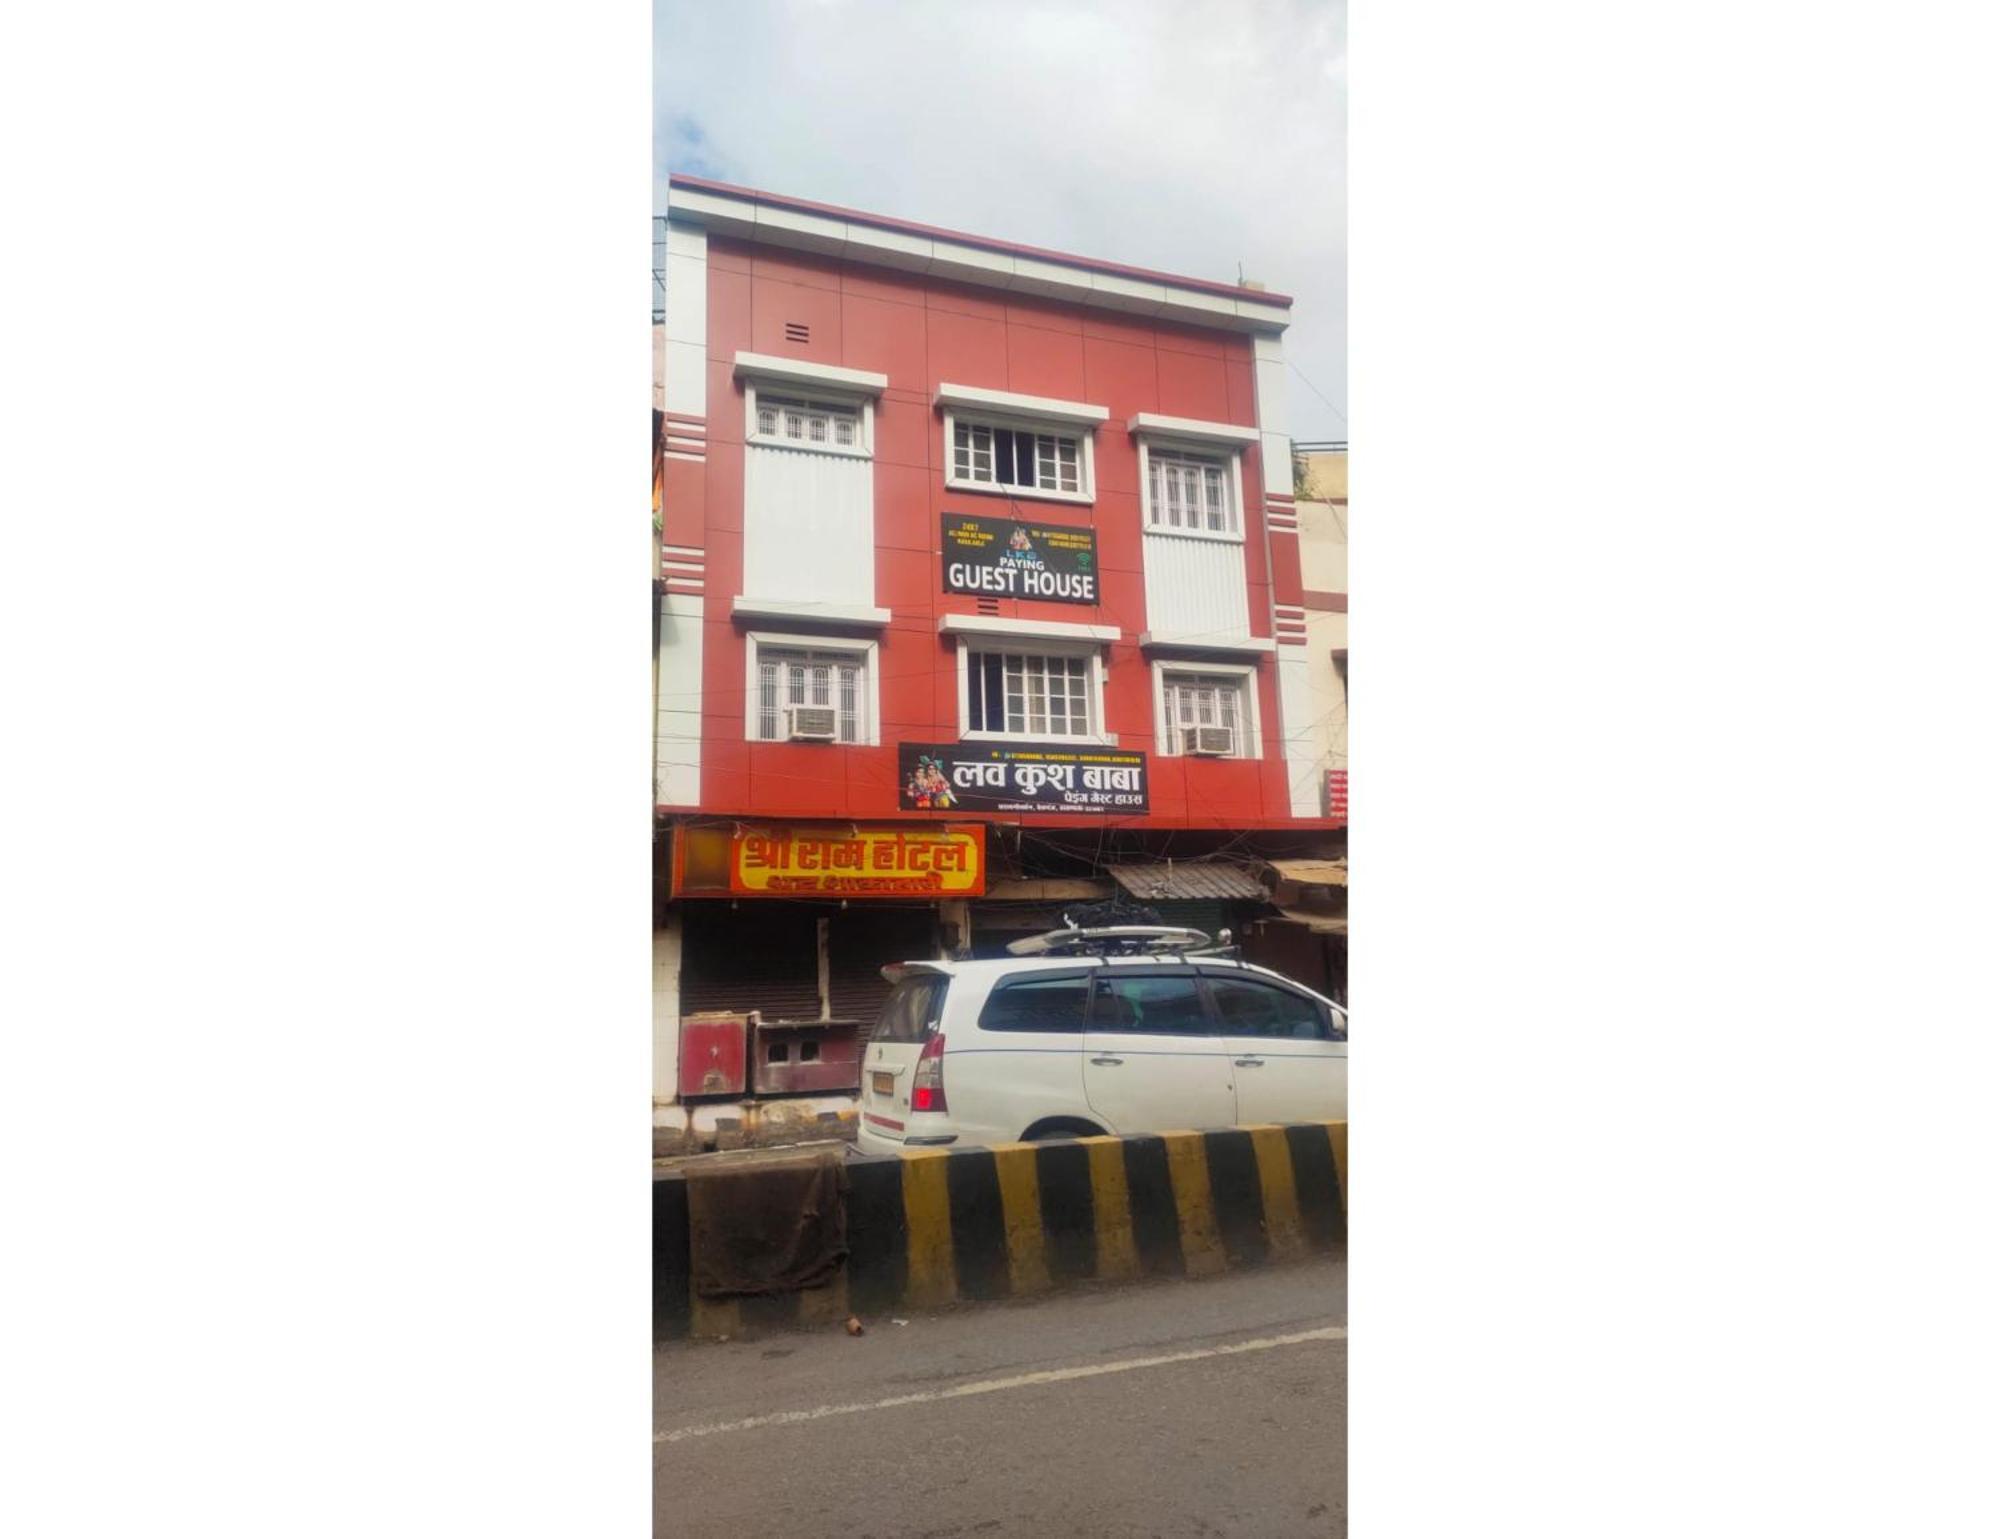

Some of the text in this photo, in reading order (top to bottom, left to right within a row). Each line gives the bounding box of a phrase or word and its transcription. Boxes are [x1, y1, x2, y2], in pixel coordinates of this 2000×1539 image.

[999, 556, 1045, 571] PAYING
[949, 563, 1094, 599] GUEST HOUSE
[952, 761, 1141, 795] लव कुश बाबा
[1114, 794, 1143, 806] हाउस
[745, 832, 968, 872] श्री राम होटल
